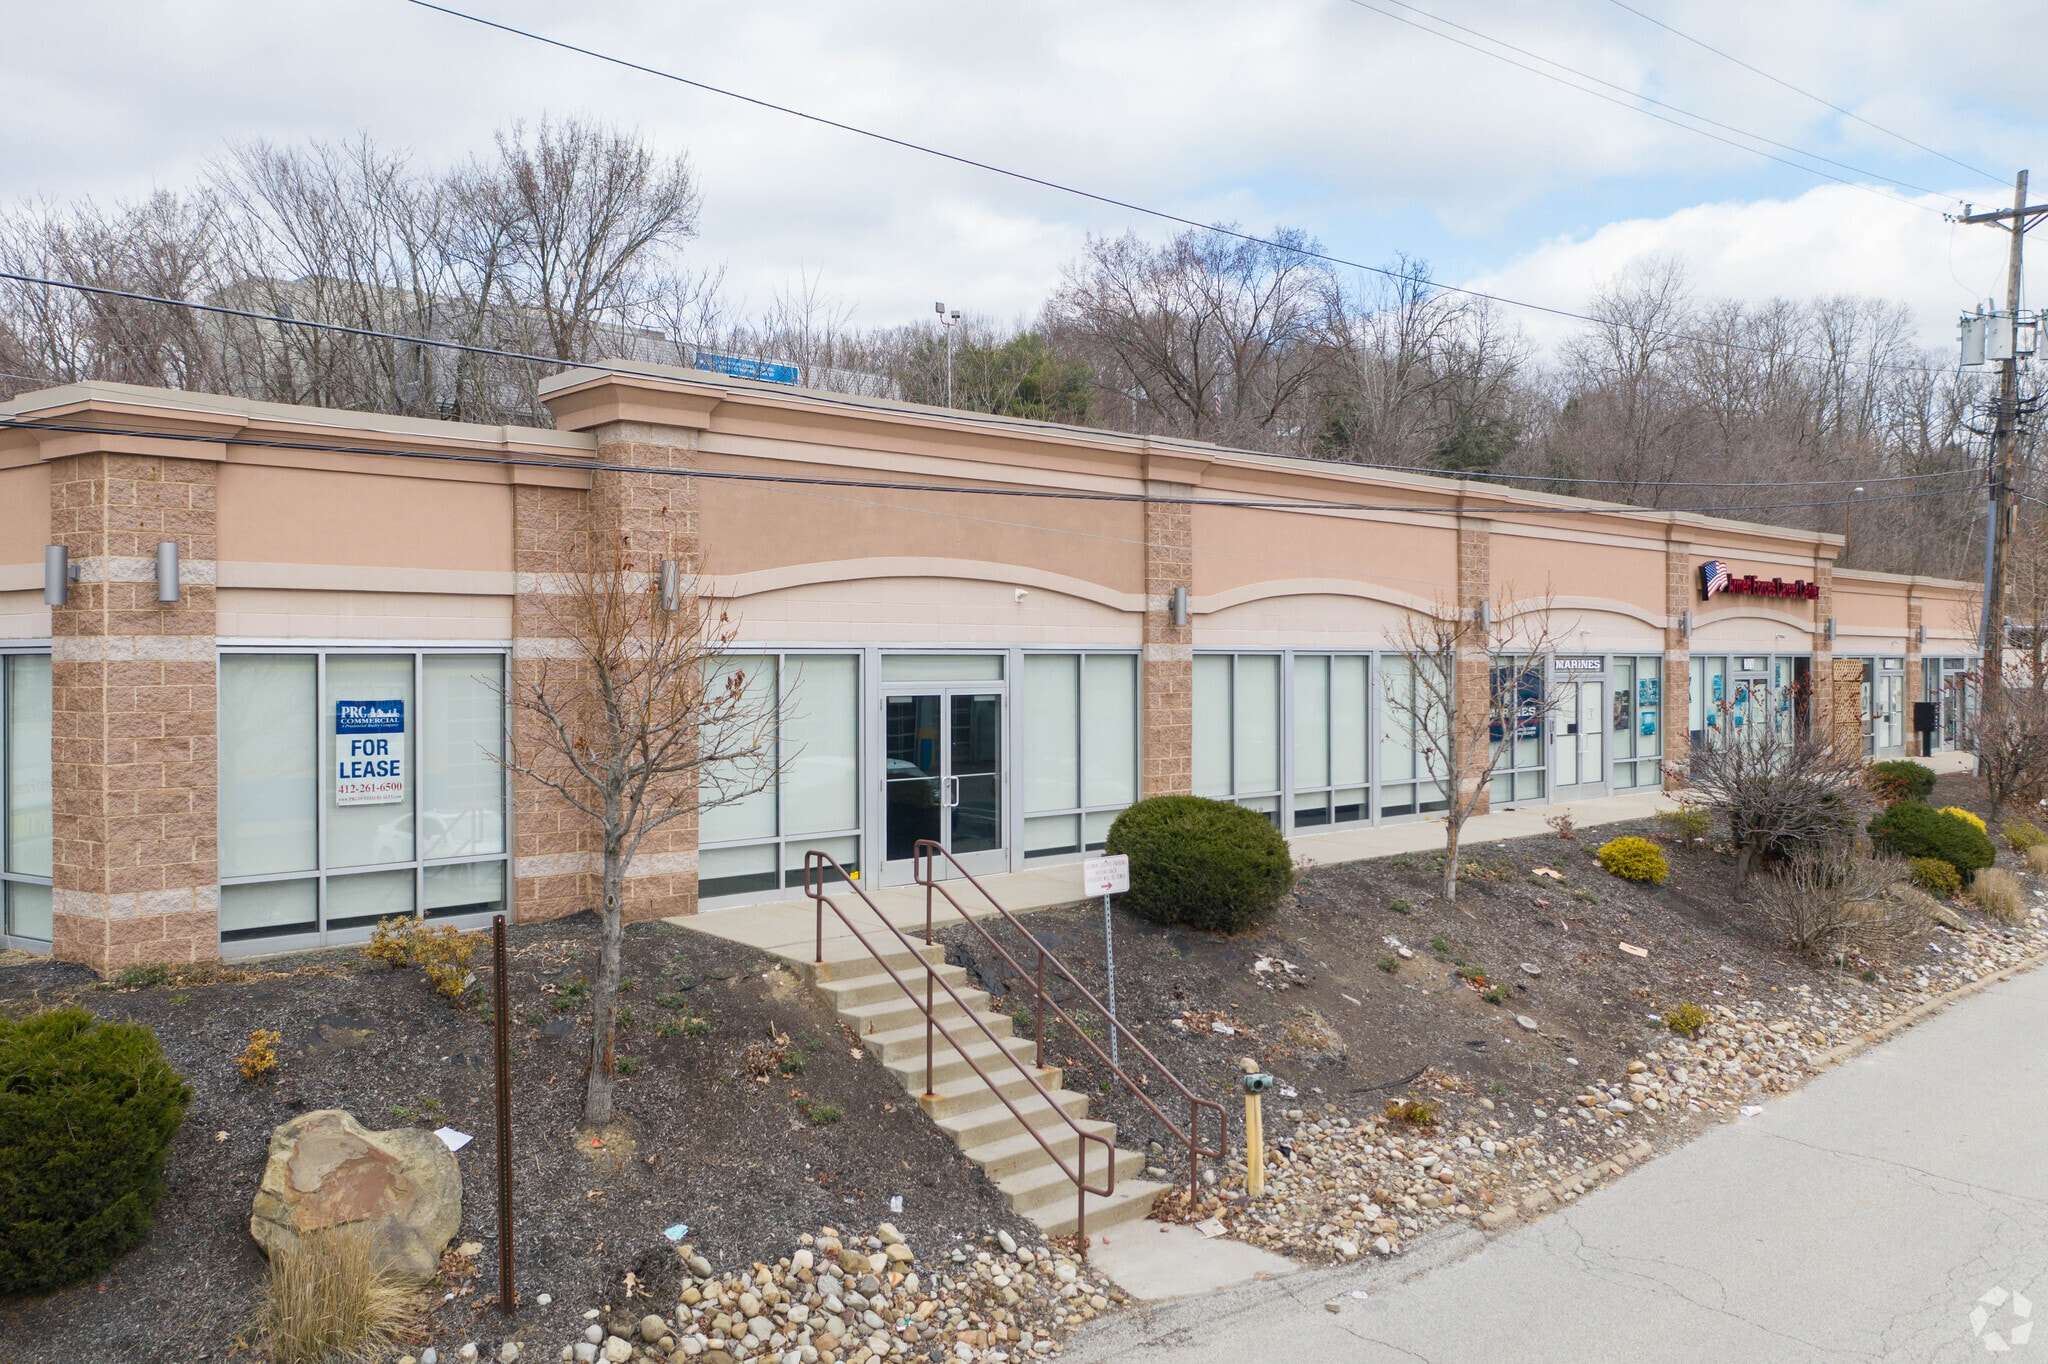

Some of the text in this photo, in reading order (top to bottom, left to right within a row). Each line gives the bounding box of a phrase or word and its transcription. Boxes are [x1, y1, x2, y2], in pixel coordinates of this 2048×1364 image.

[1555, 659, 1601, 669] MARINES
[340, 706, 367, 718] PRC
[351, 739, 388, 756] FOR
[339, 760, 400, 779] LEASE
[338, 782, 402, 794] 412-261-6500
